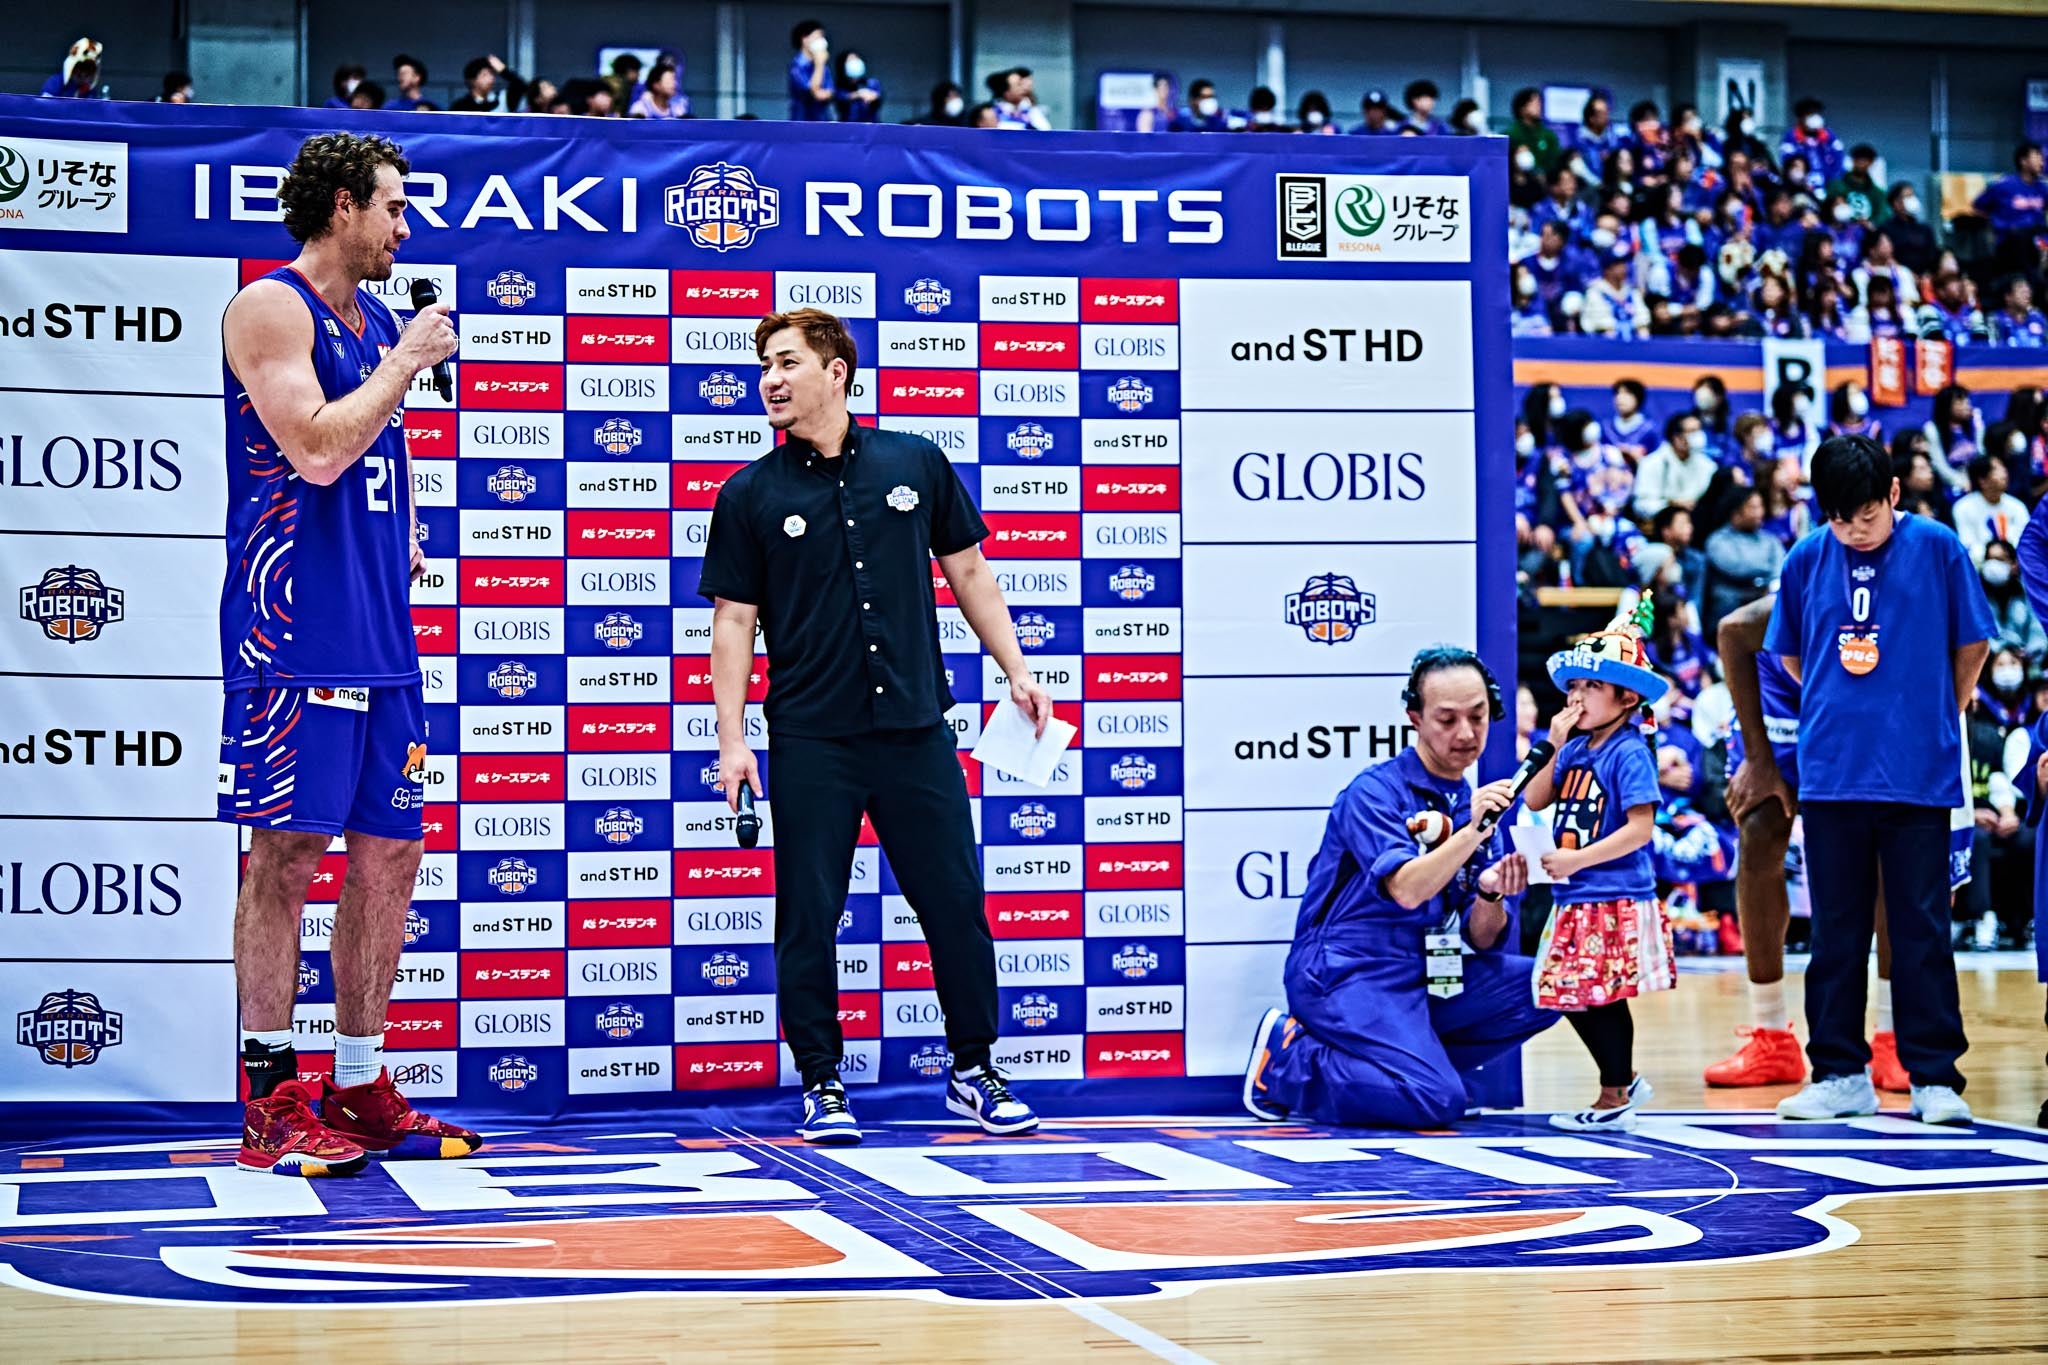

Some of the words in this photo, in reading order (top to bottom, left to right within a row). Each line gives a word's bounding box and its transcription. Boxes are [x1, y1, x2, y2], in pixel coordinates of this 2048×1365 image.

[37, 159, 116, 188] りそな
[37, 189, 116, 211] グループ
[194, 163, 638, 233] IBRAKI
[667, 188, 777, 225] ROBOTS
[805, 181, 1224, 244] ROBOTS
[1392, 195, 1460, 220] りそな
[1392, 223, 1460, 242] グループ
[1338, 242, 1382, 253] RESONA
[488, 280, 534, 297] ROBOTS
[578, 286, 605, 298] and
[607, 283, 630, 298] ST
[632, 284, 656, 298] HD
[789, 284, 863, 305] GLOBIS
[905, 288, 950, 305] ROBOTS
[991, 293, 1017, 305] and
[1019, 291, 1041, 305] ST
[1043, 292, 1067, 306] HD
[44, 302, 106, 340] ST
[114, 305, 183, 343] HD
[472, 332, 499, 344] and
[501, 330, 524, 344] ST
[527, 330, 551, 345] HD
[890, 339, 916, 351] and
[918, 337, 940, 351] ST
[943, 337, 966, 352] HD
[1231, 334, 1295, 362] and
[1303, 328, 1357, 362] ST
[1365, 329, 1423, 362] HD
[1094, 337, 1166, 357] GLOBIS
[580, 377, 656, 398] GLOBIS
[699, 380, 745, 398] ROBOTS
[994, 383, 1066, 403] GLOBIS
[1108, 386, 1152, 403] ROBOTS
[473, 425, 550, 445] GLOBIS
[594, 427, 640, 445] ROBOTS
[683, 432, 710, 445] and
[712, 430, 735, 445] ST
[737, 430, 761, 445] HD
[1008, 432, 1052, 449] ROBOTS
[1093, 436, 1119, 448] and
[1121, 434, 1142, 448] ST
[1145, 435, 1168, 449] HD
[0, 435, 182, 492] LOBIS
[488, 475, 535, 492] ROBOTS
[1232, 451, 1426, 501] GLOBIS
[364, 456, 397, 514] 21
[578, 480, 605, 492] and
[607, 478, 630, 492] ST
[633, 478, 657, 492] HD
[993, 483, 1019, 495] and
[1020, 481, 1043, 495] ST
[1045, 481, 1068, 495] HD
[472, 528, 499, 540] and
[501, 526, 524, 540] ST
[527, 526, 552, 540] HD
[1095, 526, 1167, 546] GLOBIS
[420, 575, 445, 589] HD
[580, 572, 656, 592] GLOBIS
[1109, 574, 1153, 591] ROBOTS
[22, 587, 123, 620] ROBOTS
[1285, 592, 1376, 624] ROBOTS
[1852, 587, 1871, 622] 0
[474, 620, 551, 641] GLOBIS
[595, 622, 641, 639] ROBOTS
[1094, 625, 1120, 637] and
[1122, 623, 1144, 637] ST
[1146, 623, 1169, 637] HD
[489, 671, 535, 688] ROBOTS
[579, 674, 606, 687] and
[608, 672, 631, 687] ST
[633, 672, 658, 687] HD
[472, 724, 500, 736] and
[502, 722, 525, 736] ST
[527, 722, 552, 736] HD
[1097, 714, 1169, 734] GLOBIS
[44, 728, 106, 766] ST
[115, 730, 182, 767] HD
[1234, 732, 1298, 760] and
[1307, 725, 1361, 759] ST
[581, 766, 657, 787] GLOBIS
[1111, 763, 1155, 780] ROBOTS
[474, 816, 551, 837] GLOBIS
[596, 817, 642, 834] ROBOTS
[1011, 812, 1055, 828] ROBOTS
[1096, 814, 1122, 826] and
[1123, 812, 1145, 826] ST
[1148, 812, 1171, 826] HD
[489, 867, 536, 884] ROBOTS
[580, 869, 607, 881] and
[609, 867, 632, 881] ST
[634, 867, 659, 882] HD
[995, 863, 1021, 875] and
[1023, 861, 1045, 875] ST
[1048, 861, 1071, 875] HD
[0, 862, 182, 916] LOBIS
[688, 911, 762, 931] GLOBIS
[1098, 903, 1170, 923] GLOBIS
[473, 920, 500, 932] and
[502, 918, 525, 932] ST
[528, 918, 553, 932] HD
[1112, 952, 1156, 969] ROBOTS
[420, 970, 446, 984] HD
[582, 961, 658, 982] GLOBIS
[702, 961, 748, 978] ROBOTS
[1012, 1002, 1056, 1019] ROBOTS
[1097, 1003, 1123, 1015] and
[1125, 1001, 1147, 1015] ST
[1149, 1001, 1172, 1015] HD
[475, 1013, 552, 1034] GLOBIS
[597, 1012, 643, 1029] ROBOTS
[686, 1013, 713, 1025] and
[715, 1011, 738, 1025] ST
[740, 1011, 764, 1025] HD
[19, 1012, 122, 1043] ROBOTS
[995, 1053, 1021, 1065] and
[1023, 1051, 1045, 1065] ST
[1047, 1051, 1071, 1065] HD
[490, 1064, 536, 1081] ROBOTS
[581, 1064, 608, 1076] and
[609, 1062, 632, 1076] ST
[635, 1062, 659, 1077] HD
